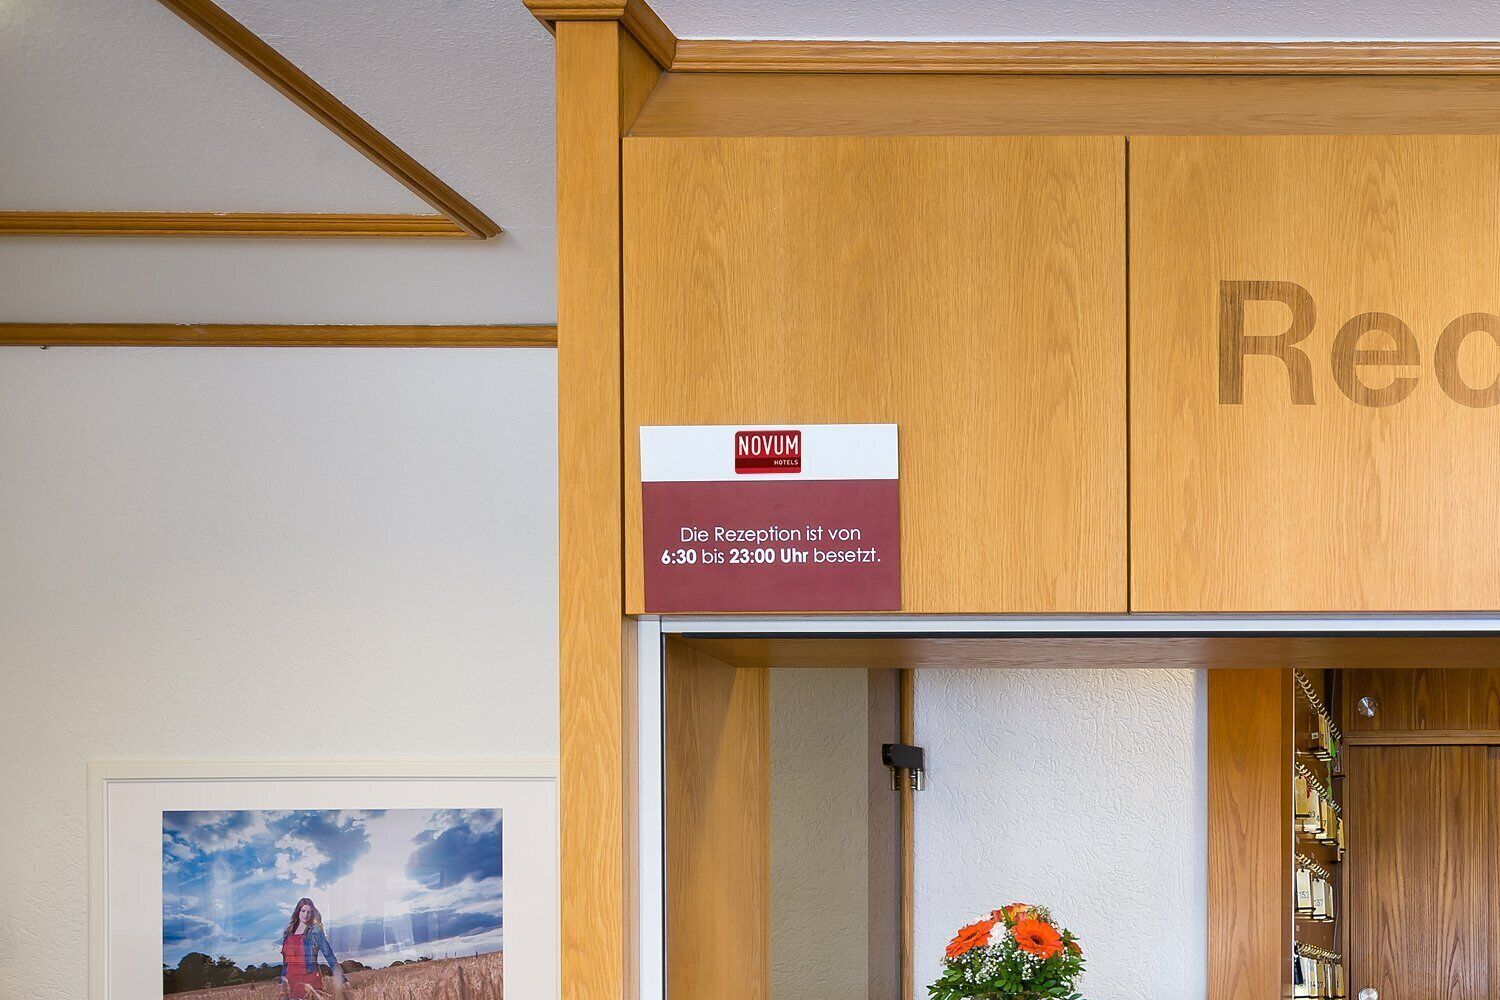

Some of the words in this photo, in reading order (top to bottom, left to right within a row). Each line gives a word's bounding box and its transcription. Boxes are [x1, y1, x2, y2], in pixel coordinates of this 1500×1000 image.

[738, 434, 799, 456] NOVUM
[680, 527, 709, 543] Die
[714, 525, 801, 545] Rezeption
[806, 525, 823, 541] ist
[827, 527, 861, 541] von
[661, 549, 697, 565] 6:30
[702, 548, 725, 564] bis
[729, 548, 776, 564] 23:00
[781, 548, 809, 563] Uhr
[813, 547, 881, 563] besetzt.
